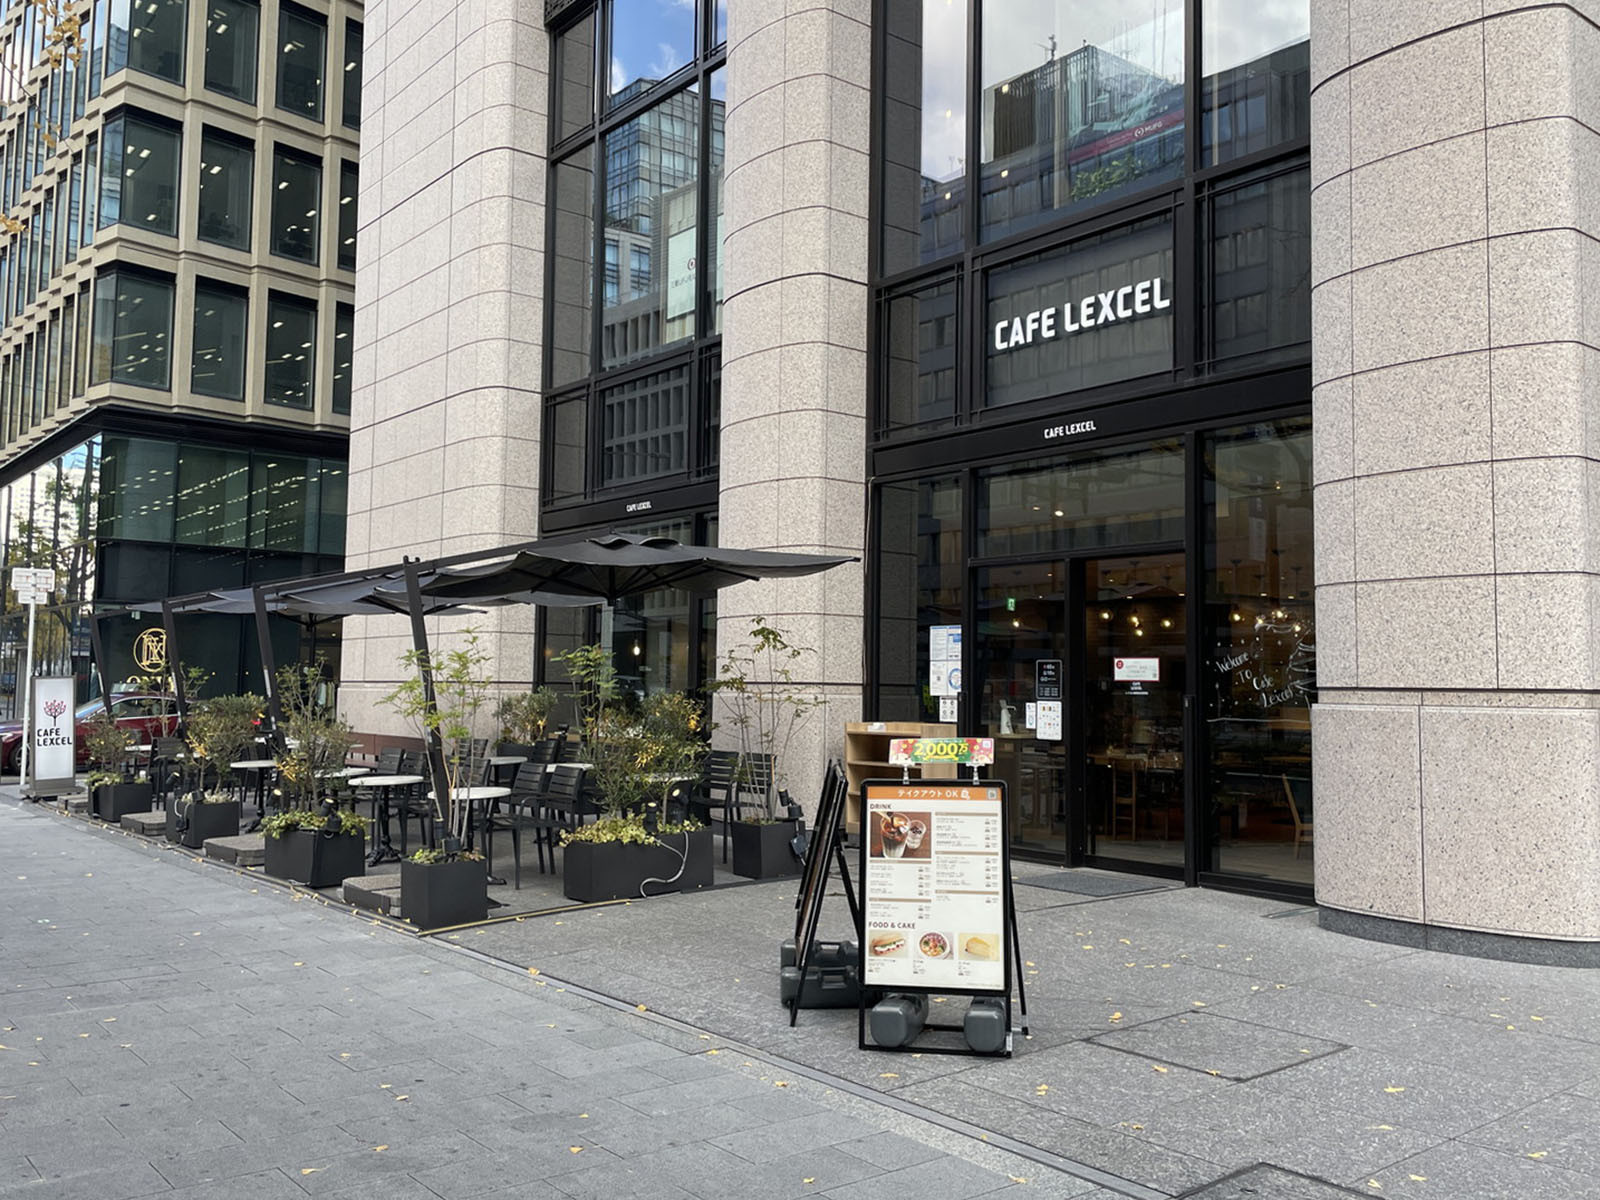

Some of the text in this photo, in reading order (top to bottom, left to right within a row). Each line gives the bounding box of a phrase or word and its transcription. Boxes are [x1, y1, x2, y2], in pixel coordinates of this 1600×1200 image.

[995, 277, 1170, 350] CAFE LEXCEL
[1044, 420, 1096, 439] CAFE LEXCEL
[37, 728, 61, 737] CAFE
[37, 736, 72, 747] LEXCEL
[868, 921, 889, 929] FOOD
